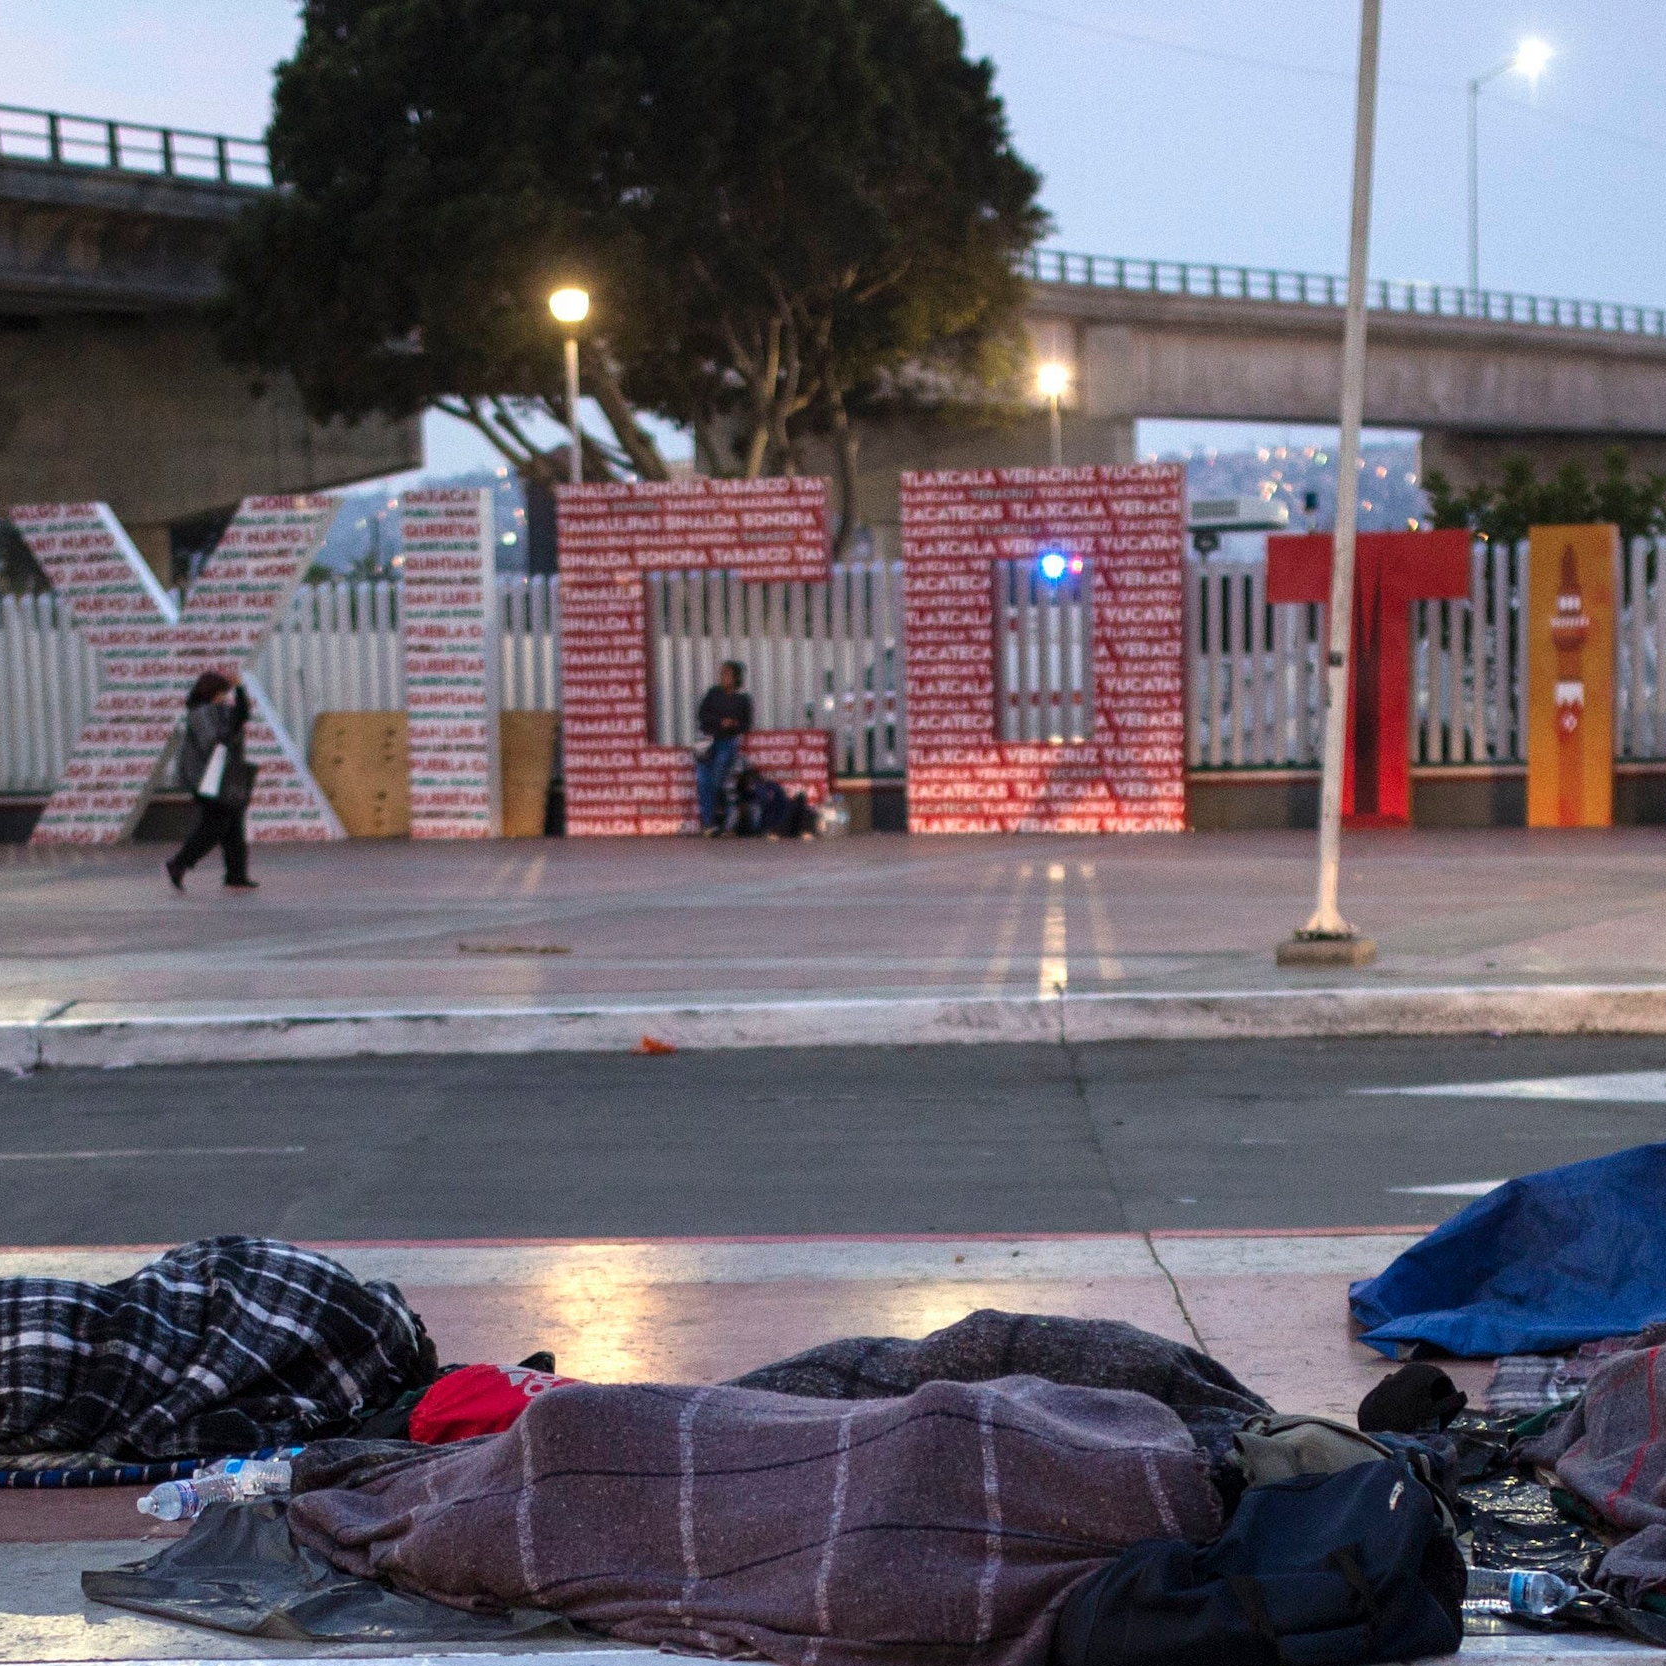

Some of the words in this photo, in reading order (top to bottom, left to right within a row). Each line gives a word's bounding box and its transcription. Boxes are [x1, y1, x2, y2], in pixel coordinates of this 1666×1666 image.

[901, 469, 995, 486] TLAXCALA
[1002, 466, 1097, 483] VERACRUZ
[558, 484, 628, 498] SINALOA
[712, 477, 788, 493] TABASCO
[665, 514, 736, 529] SINALOA
[743, 511, 815, 526] SONORA
[902, 504, 1002, 521] ZACATECAS
[1012, 501, 1105, 518] TLAXCALA
[559, 552, 631, 567] SINALOA
[637, 550, 707, 565] SONORA
[714, 547, 791, 562] TABASCO
[903, 541, 993, 556] TLAXCALA
[908, 750, 1000, 763] TLAXCALA
[1007, 748, 1098, 762] VERACRUZ
[908, 783, 1006, 798] ZACATECAS
[1016, 783, 1108, 797] TLAXCALA
[909, 819, 1001, 833] TLAXCALA
[1008, 818, 1100, 833] VERACRUZ
